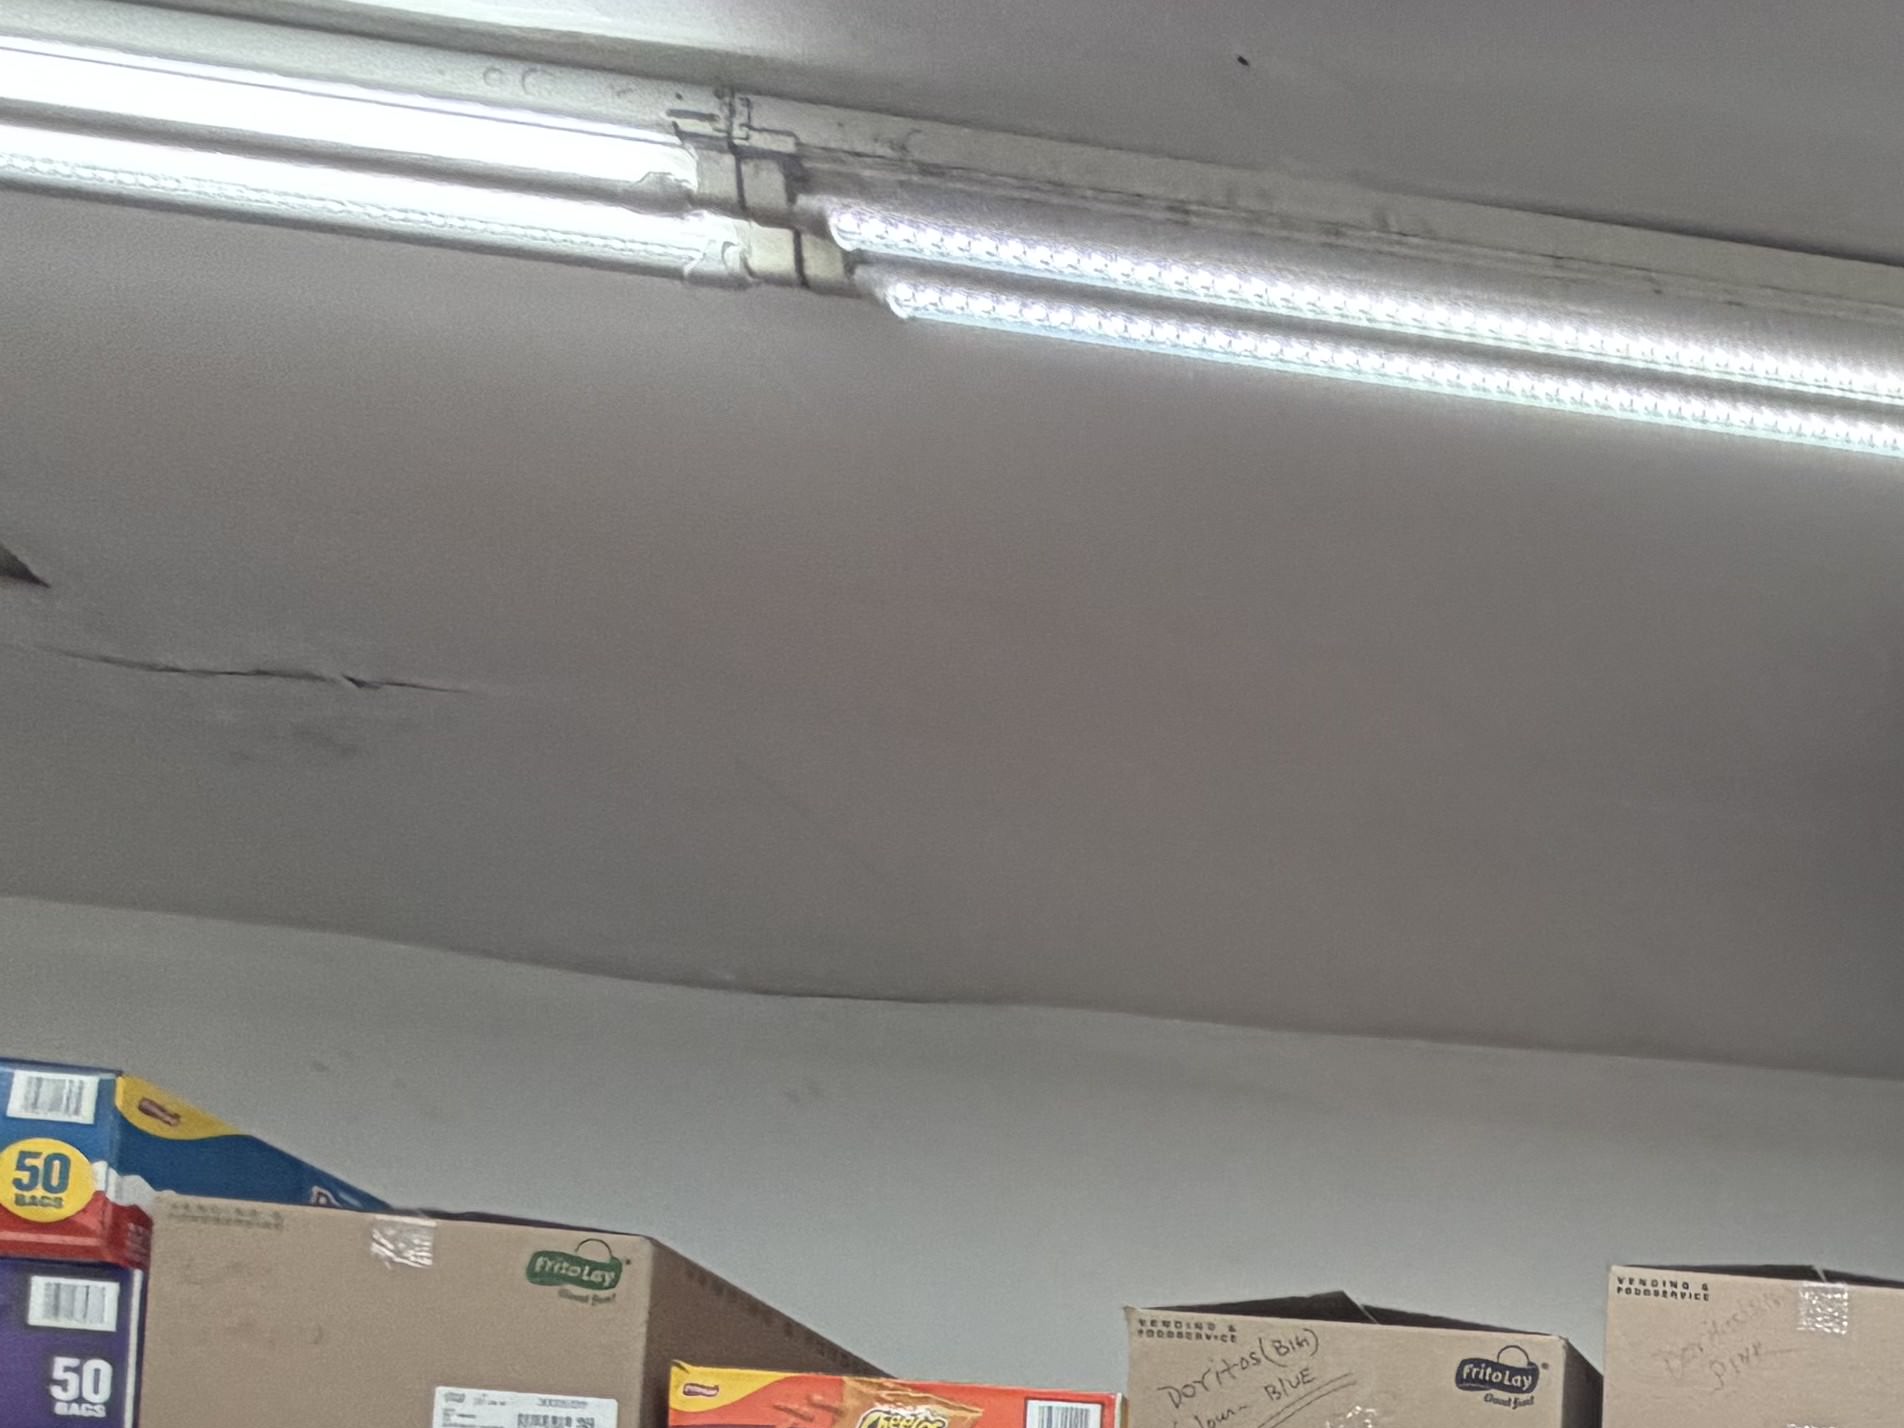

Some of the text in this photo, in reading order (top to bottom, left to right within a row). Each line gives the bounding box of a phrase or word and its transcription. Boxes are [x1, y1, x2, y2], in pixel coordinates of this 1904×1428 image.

[12, 1151, 71, 1194] 50
[15, 1194, 64, 1209] BAGS
[50, 1356, 113, 1404] 50
[54, 1402, 106, 1418] BAGS
